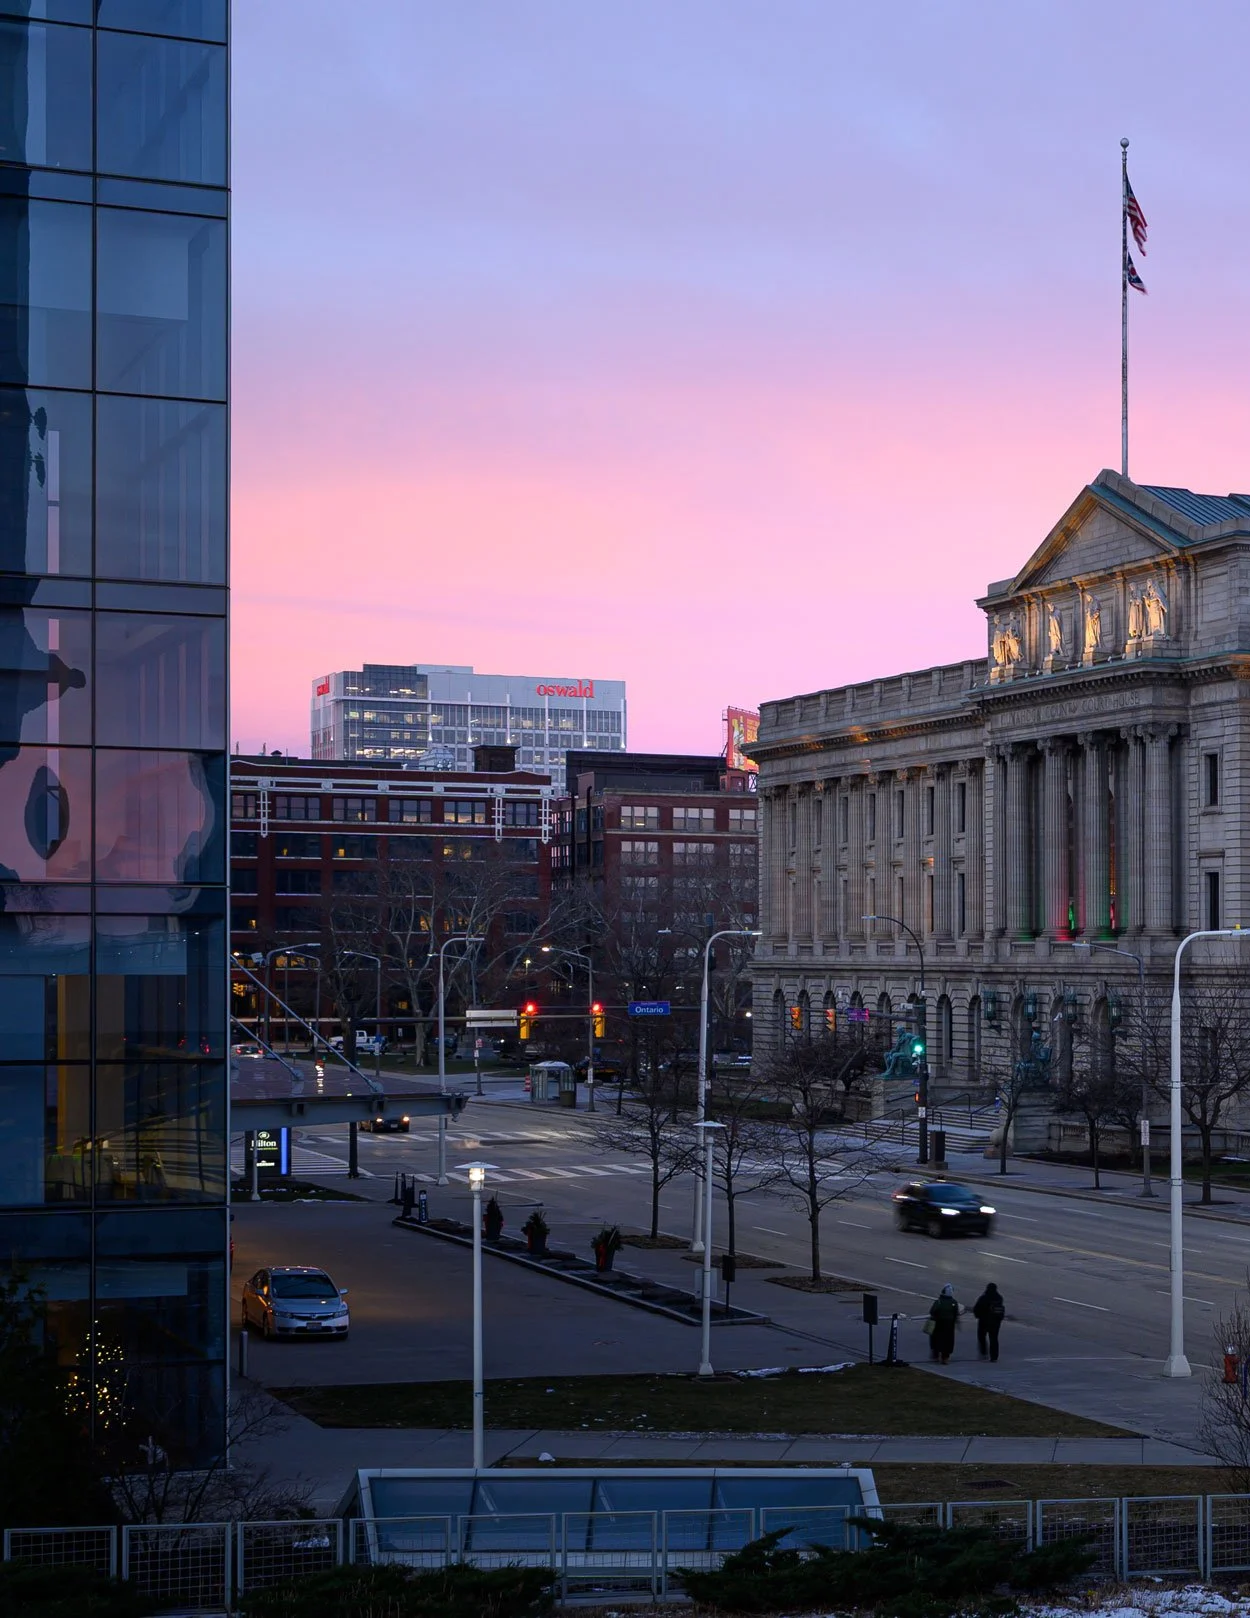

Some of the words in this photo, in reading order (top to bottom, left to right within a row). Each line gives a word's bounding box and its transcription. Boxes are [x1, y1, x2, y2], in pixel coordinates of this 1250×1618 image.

[536, 679, 594, 698] oswald
[1045, 702, 1078, 719] COUNTY
[1082, 696, 1109, 713] COURT
[1113, 691, 1140, 708] HOUSE
[635, 1005, 664, 1014] Ontario
